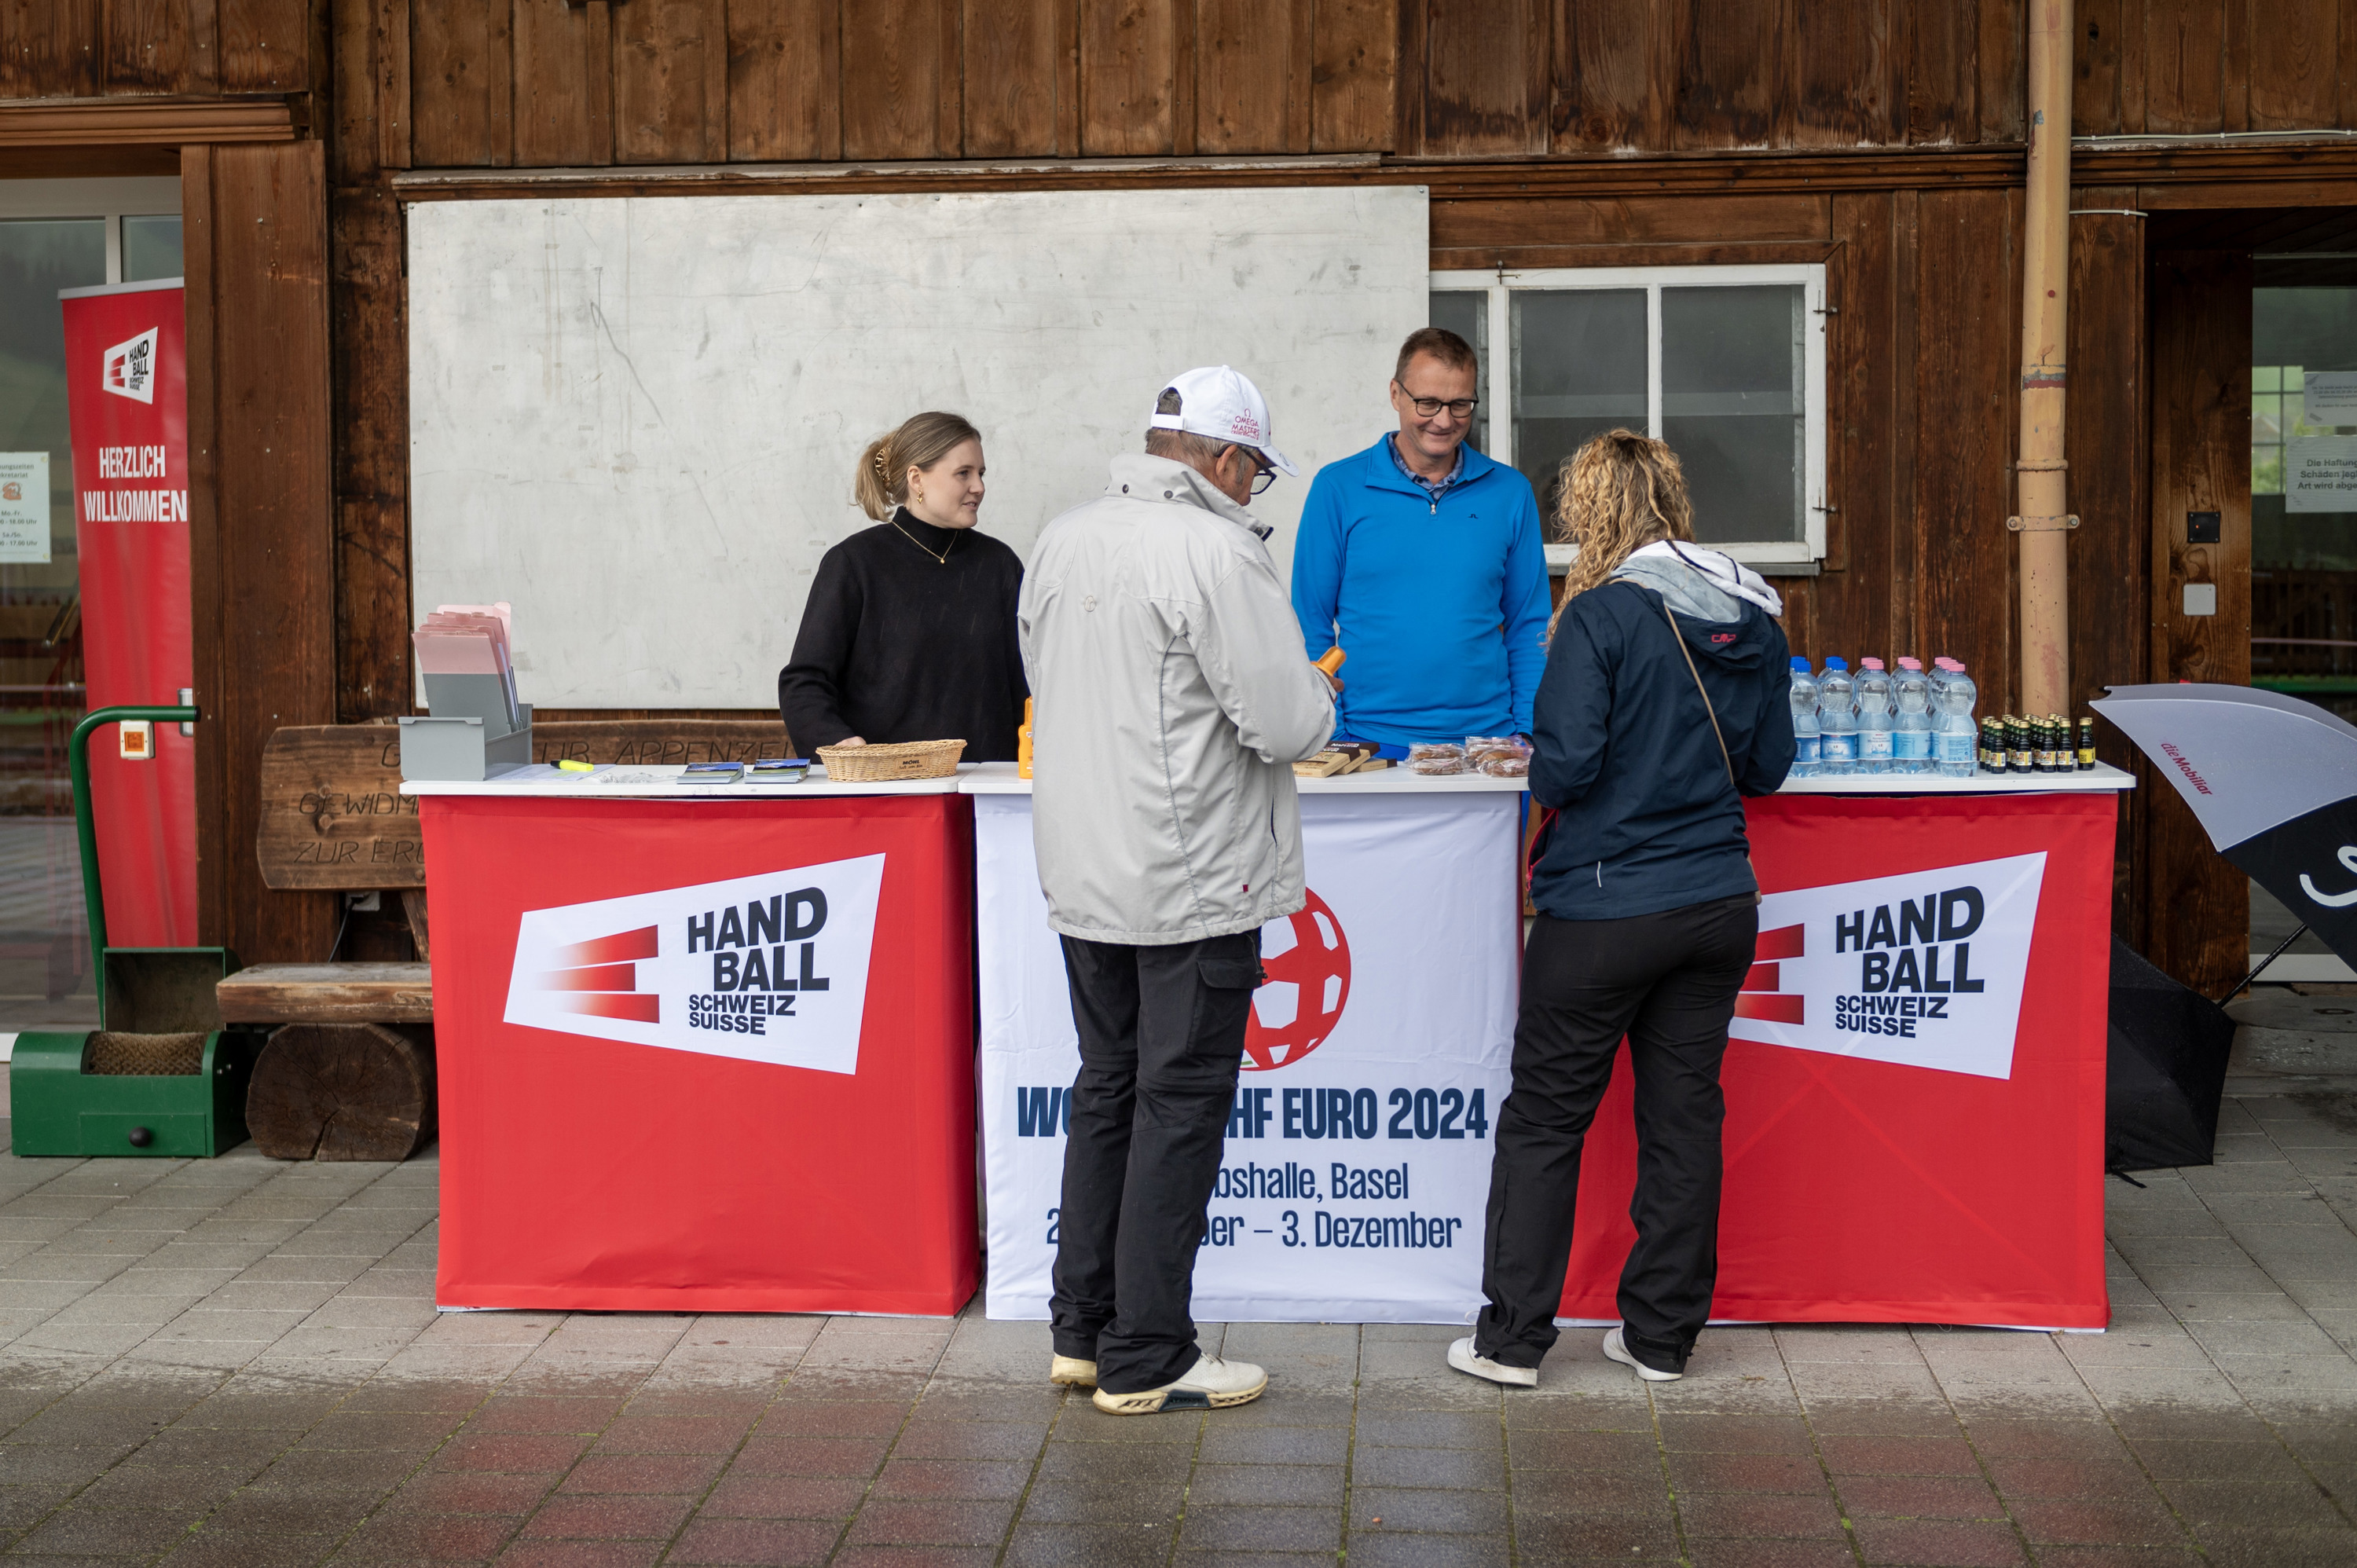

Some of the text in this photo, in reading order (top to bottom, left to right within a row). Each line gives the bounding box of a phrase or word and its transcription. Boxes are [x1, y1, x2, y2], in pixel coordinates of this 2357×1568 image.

[130, 339, 149, 363] HAND
[133, 358, 149, 376] BALL
[1234, 416, 1259, 428] OMEGA
[99, 445, 166, 478] HERZLICH
[84, 490, 188, 522] WILLKOMMEN
[2172, 757, 2213, 796] Mobiliar
[299, 793, 420, 815] GEWIDM
[294, 841, 359, 863] ZUR
[687, 886, 828, 954] HAND
[1835, 885, 1985, 954] HAND
[713, 941, 830, 992] BALL
[1862, 942, 1985, 994] BALL
[688, 994, 797, 1017] SCHWEIZ
[1835, 995, 1948, 1019] SCHWEIZ
[688, 1012, 766, 1035] SUISSE
[1835, 1013, 1916, 1039] SUISSE
[1223, 1087, 1273, 1139] HF
[1282, 1087, 1377, 1140] EURO
[1387, 1087, 1488, 1140] 2024
[1214, 1162, 1409, 1203] bshalle, Basel
[1281, 1210, 1307, 1247] 3.
[1314, 1210, 1462, 1249] Dezember
